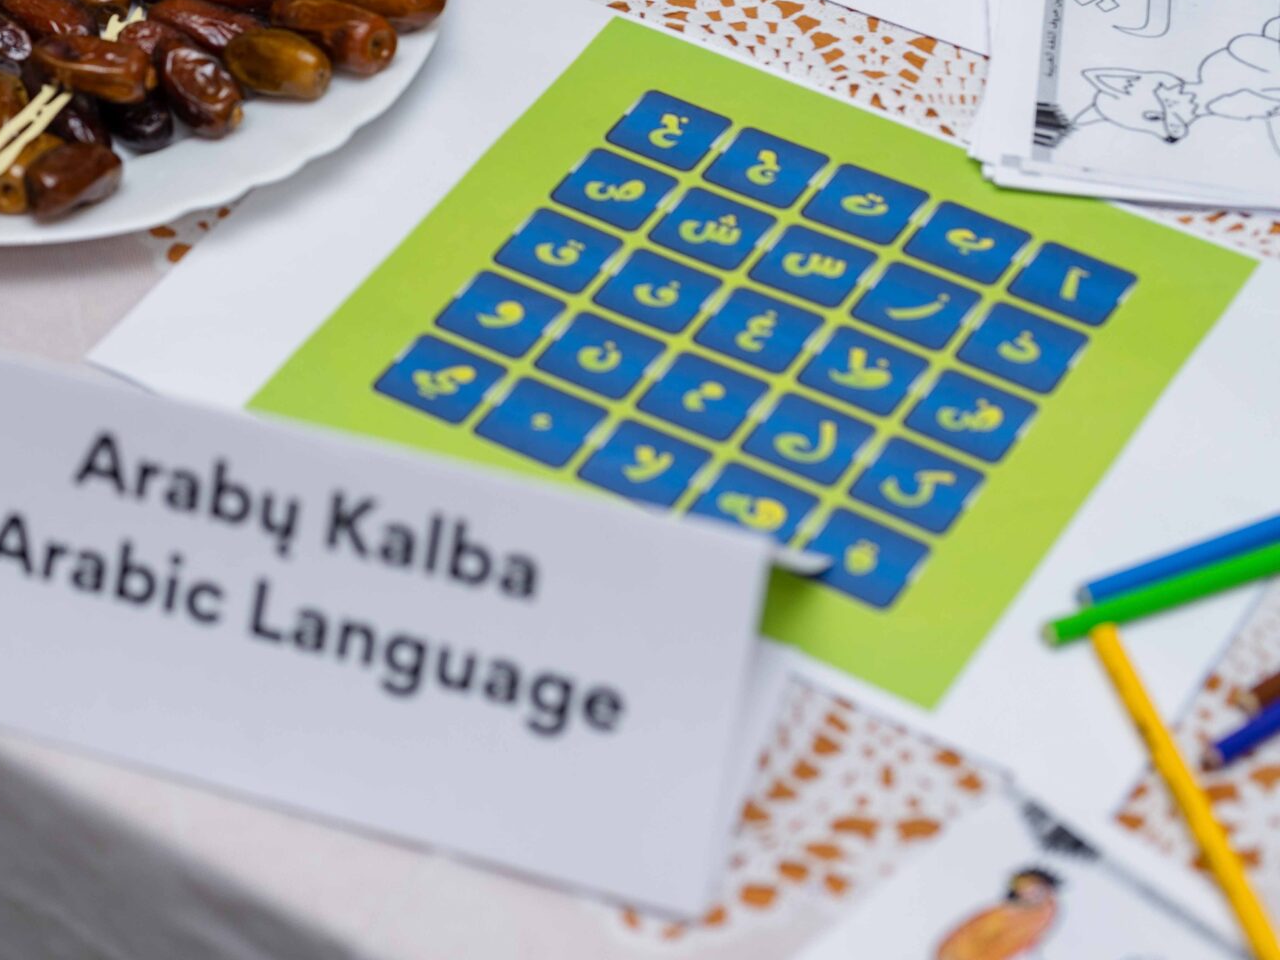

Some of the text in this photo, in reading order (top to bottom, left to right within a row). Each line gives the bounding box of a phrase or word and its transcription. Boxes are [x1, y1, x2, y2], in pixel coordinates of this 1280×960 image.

[584, 179, 647, 202] ص
[679, 214, 742, 246] ش
[782, 252, 847, 278] س
[476, 301, 525, 328] و
[75, 430, 541, 601] Arabų Kalba
[251, 579, 627, 739] Language
